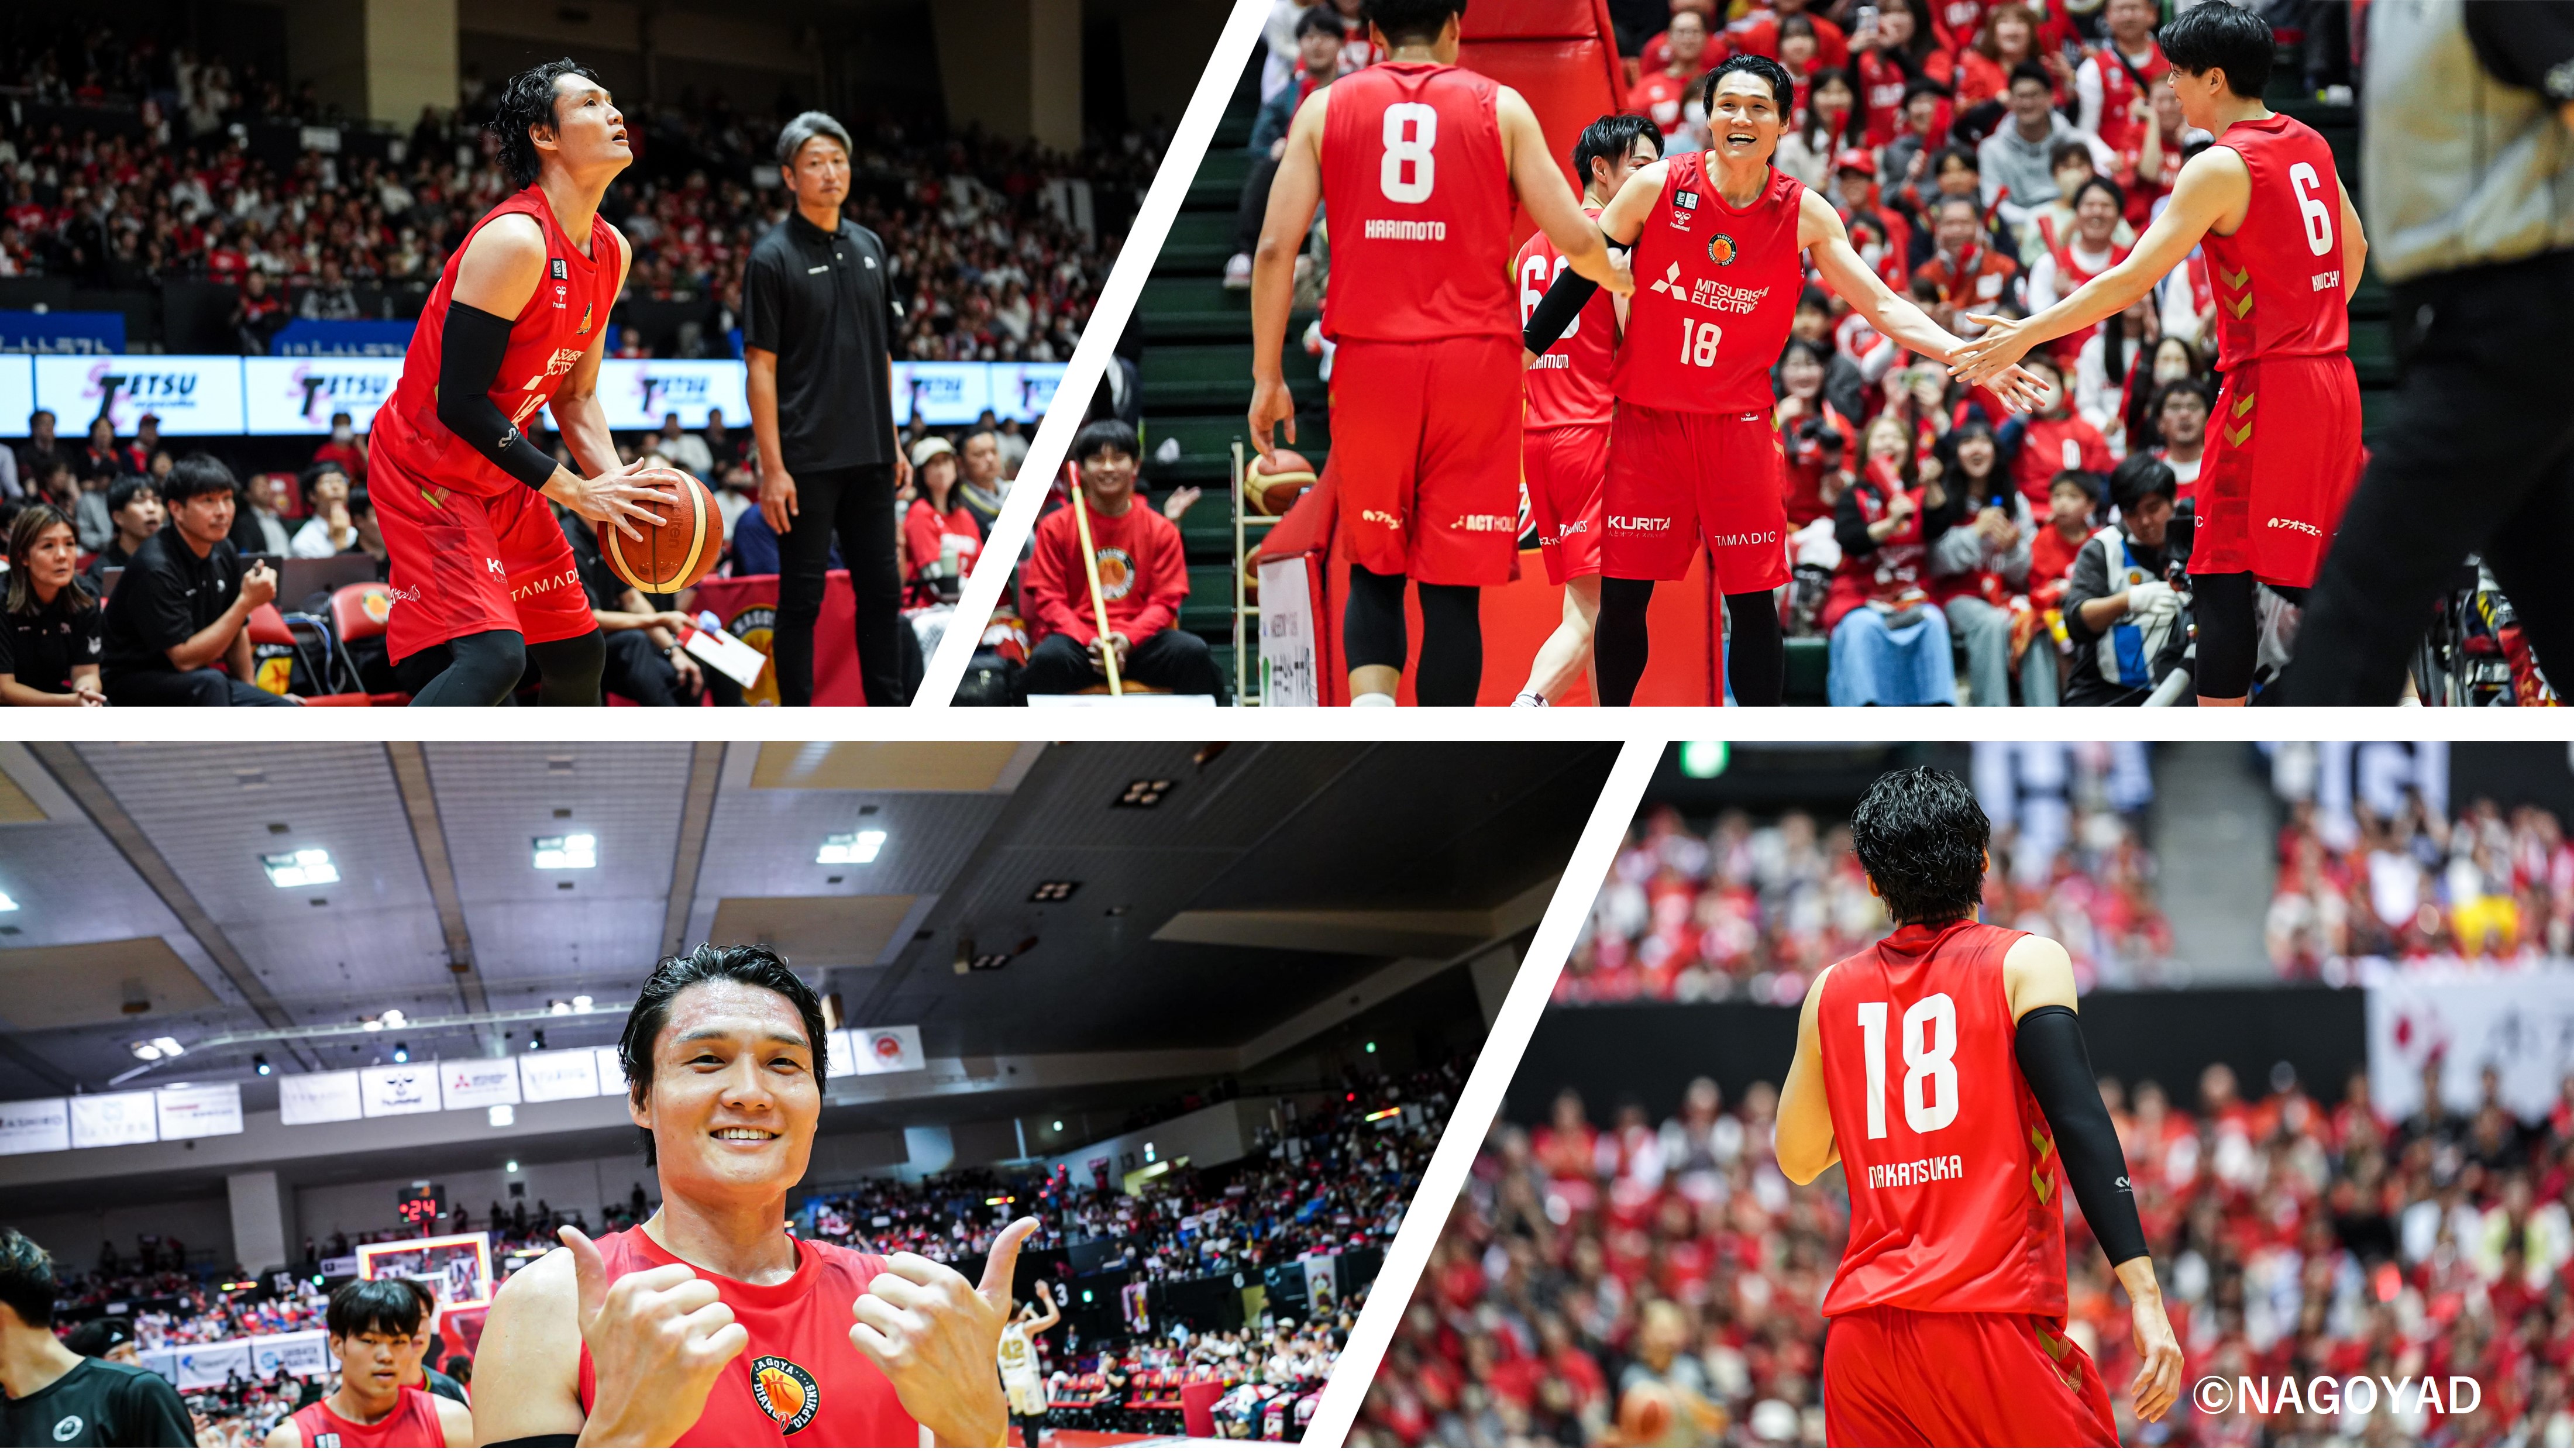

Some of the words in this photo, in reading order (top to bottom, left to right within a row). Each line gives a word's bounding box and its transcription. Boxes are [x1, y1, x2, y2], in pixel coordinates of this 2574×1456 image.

[1381, 102, 1437, 204] 8
[2289, 162, 2334, 256] 6
[1365, 219, 1446, 241] HARIMOTO
[1670, 221, 1691, 232] hummel
[1695, 278, 1770, 302] MITSUBISHI
[1691, 291, 1758, 315] ELECTRIC
[1680, 318, 1722, 367] 18
[1608, 515, 1671, 531] KURITA
[1714, 530, 1776, 547] TAMADIC
[1858, 993, 1959, 1140] 18
[1868, 1154, 1963, 1189] NAKATSUKA
[408, 1199, 436, 1221] 24
[1055, 1283, 1069, 1307] 3
